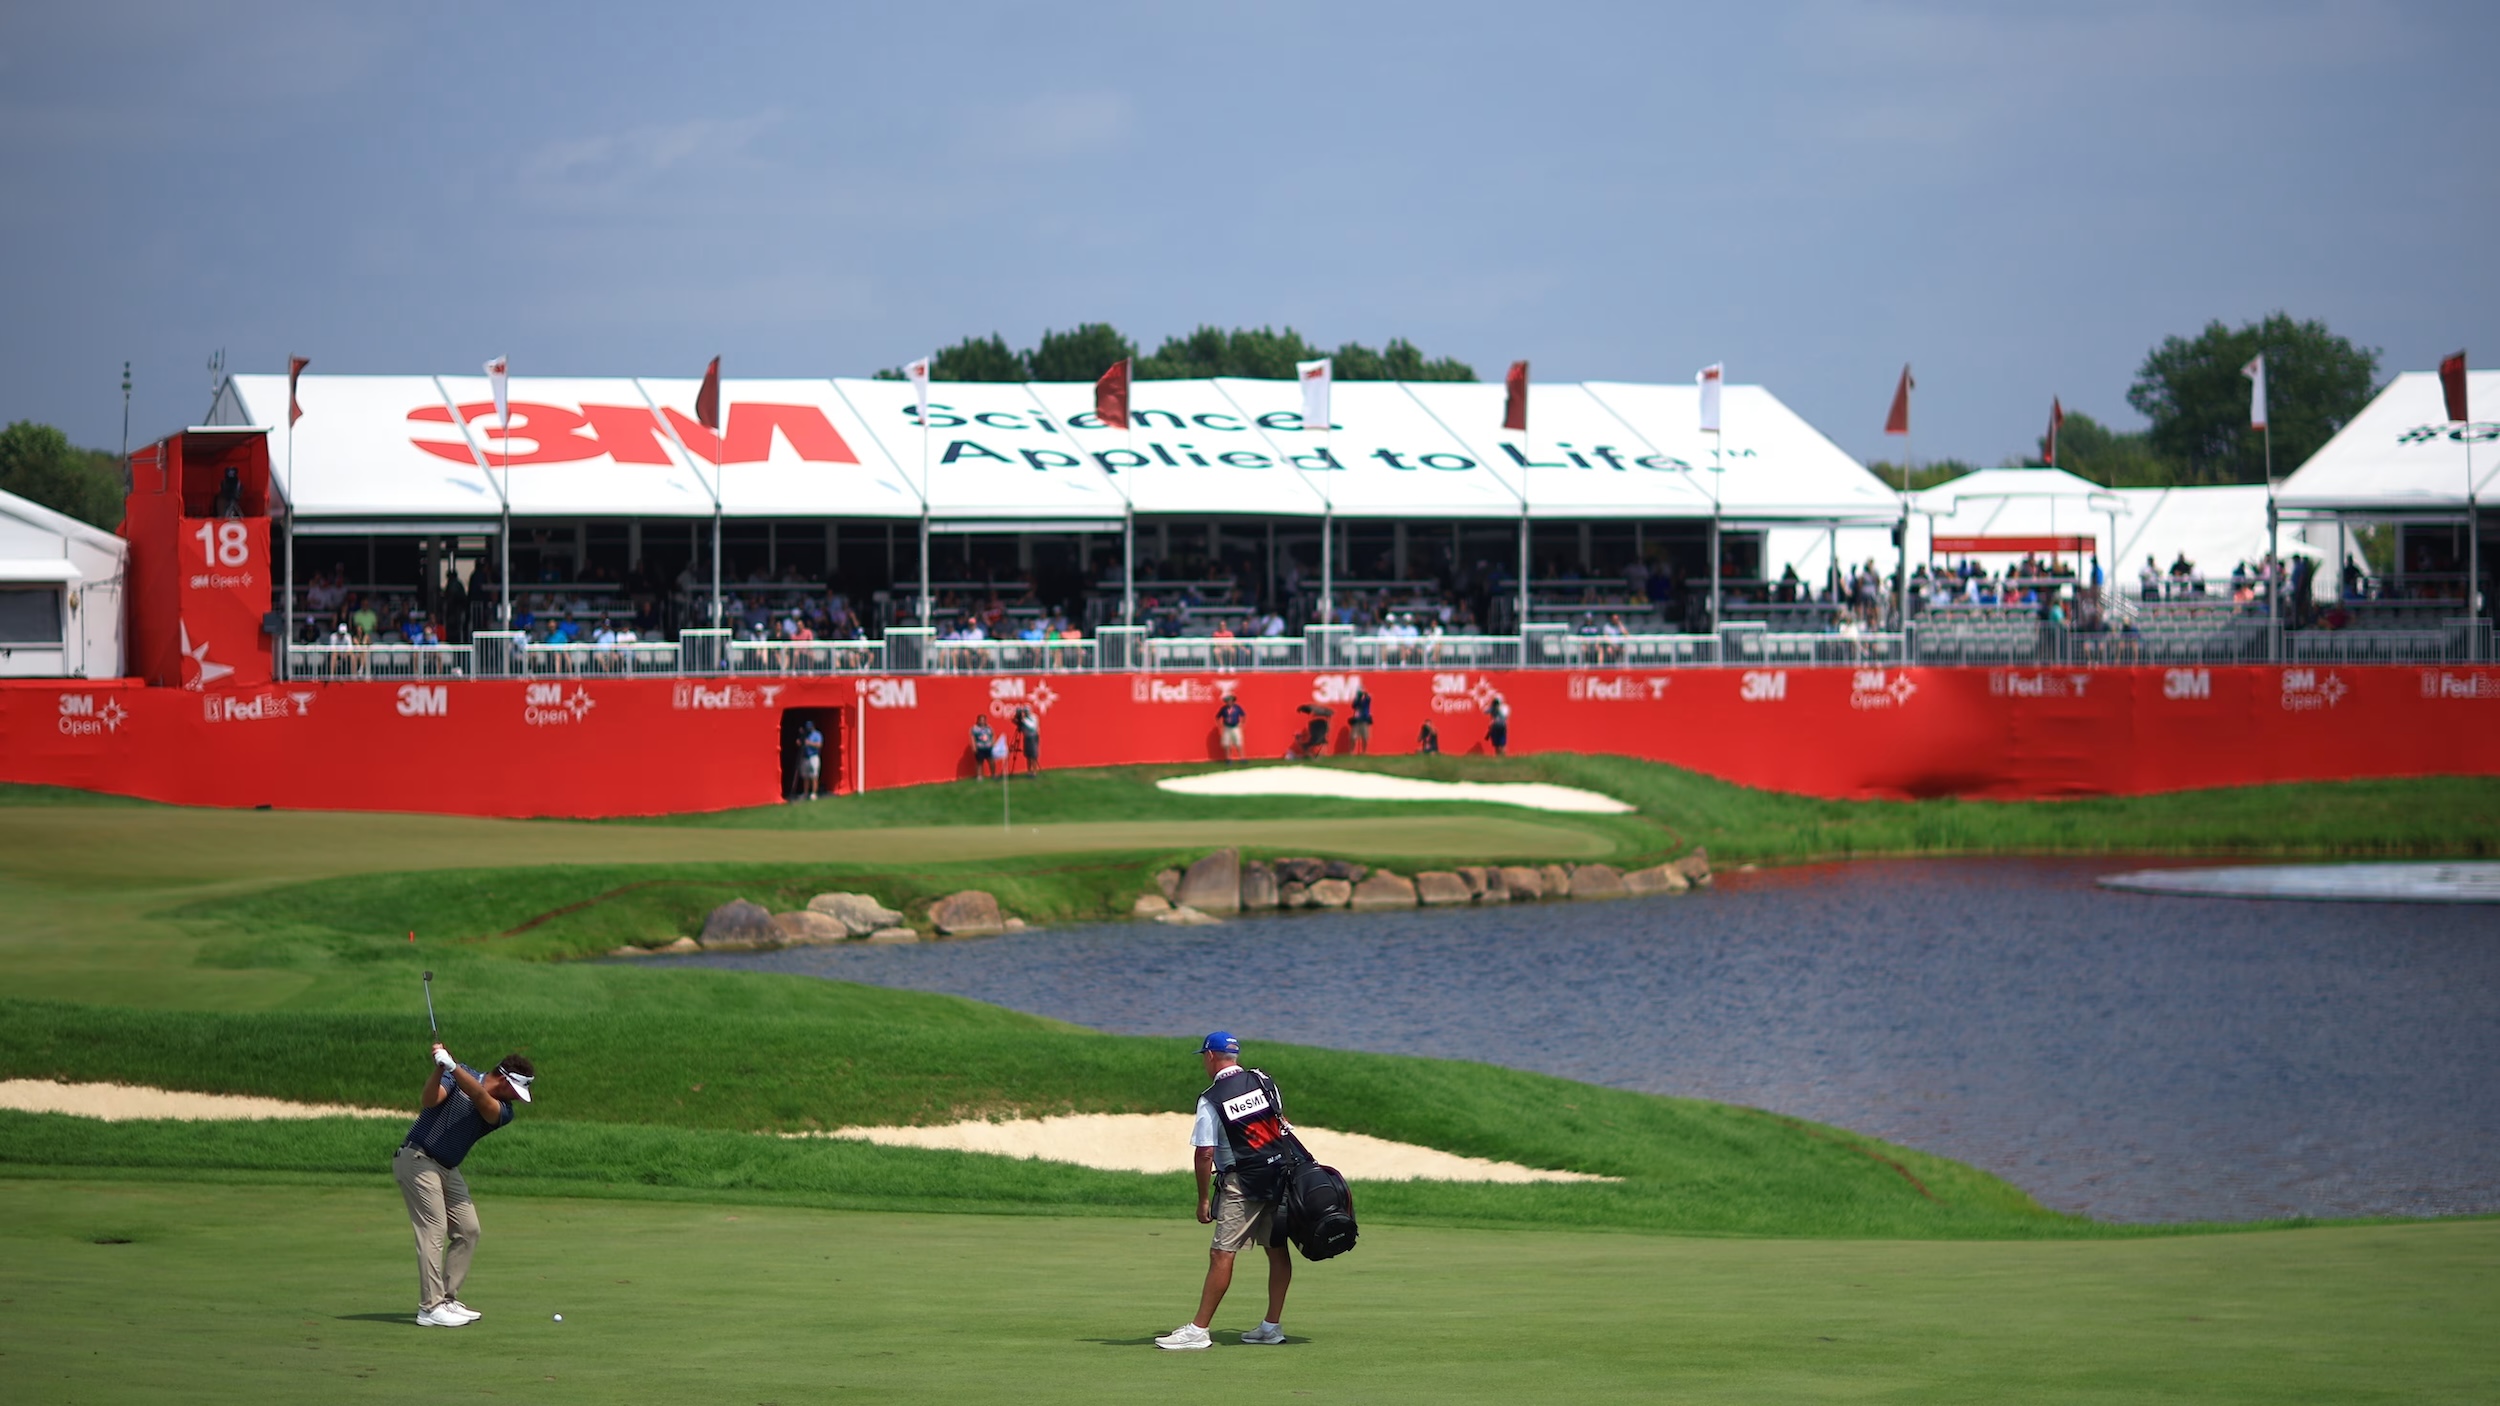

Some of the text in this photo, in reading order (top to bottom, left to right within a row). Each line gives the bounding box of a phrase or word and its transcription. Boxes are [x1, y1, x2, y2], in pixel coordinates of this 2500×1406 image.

[406, 401, 861, 467] 3M
[940, 440, 1345, 474] Applied
[1370, 448, 1476, 471] to
[195, 521, 249, 567] 18
[210, 574, 240, 590] Open
[990, 678, 1025, 699] 3M
[1150, 679, 1212, 703] FedEx
[1312, 674, 1361, 703] 3M
[1432, 673, 1467, 695] 3M
[1586, 676, 1646, 699] FedEx
[1740, 671, 1787, 701] 3M
[1852, 670, 1886, 691] 3M
[2163, 668, 2211, 699] 3M
[2281, 670, 2315, 692] 3M
[396, 684, 448, 716] 3M
[525, 684, 562, 706] 3M
[693, 685, 755, 709] FedEx
[868, 678, 917, 708] 3M
[1850, 692, 1892, 710] Open
[2281, 692, 2323, 712] Open
[58, 694, 93, 715] 3M
[224, 693, 288, 721] FedEx
[1430, 697, 1473, 714] Open
[58, 716, 102, 737] Open
[524, 706, 569, 727] Open
